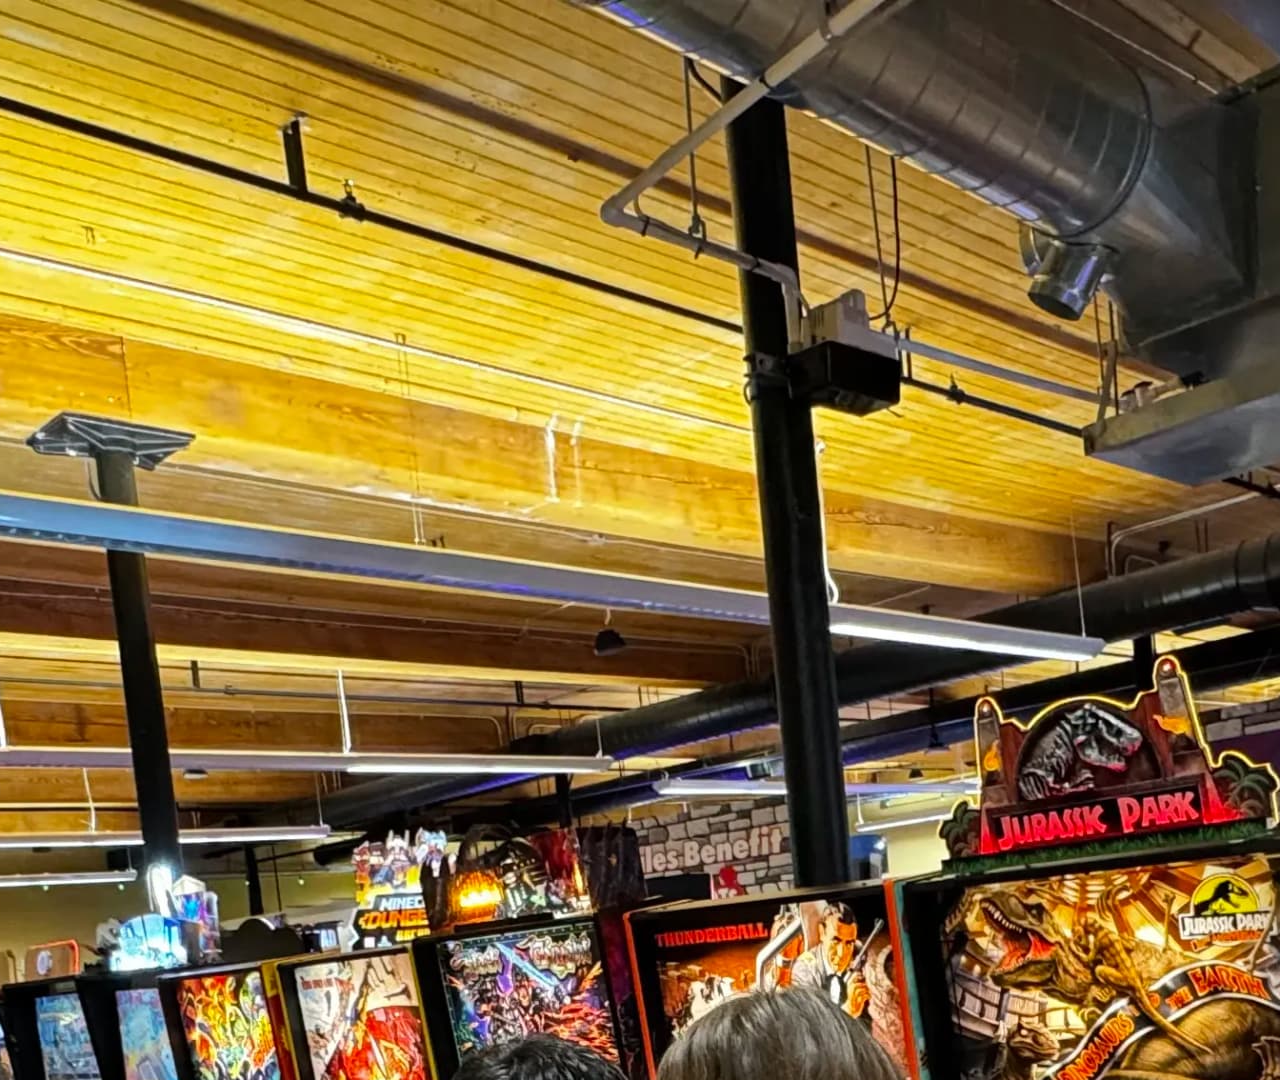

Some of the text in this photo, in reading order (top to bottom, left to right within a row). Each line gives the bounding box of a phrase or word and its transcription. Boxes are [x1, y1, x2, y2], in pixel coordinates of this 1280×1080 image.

[998, 790, 1199, 851] JURASSIC PARK
[684, 826, 783, 867] Benefit
[655, 922, 768, 948] THUNDERBALL
[1182, 915, 1236, 936] JURASSIC
[1187, 965, 1272, 1001] EARTH
